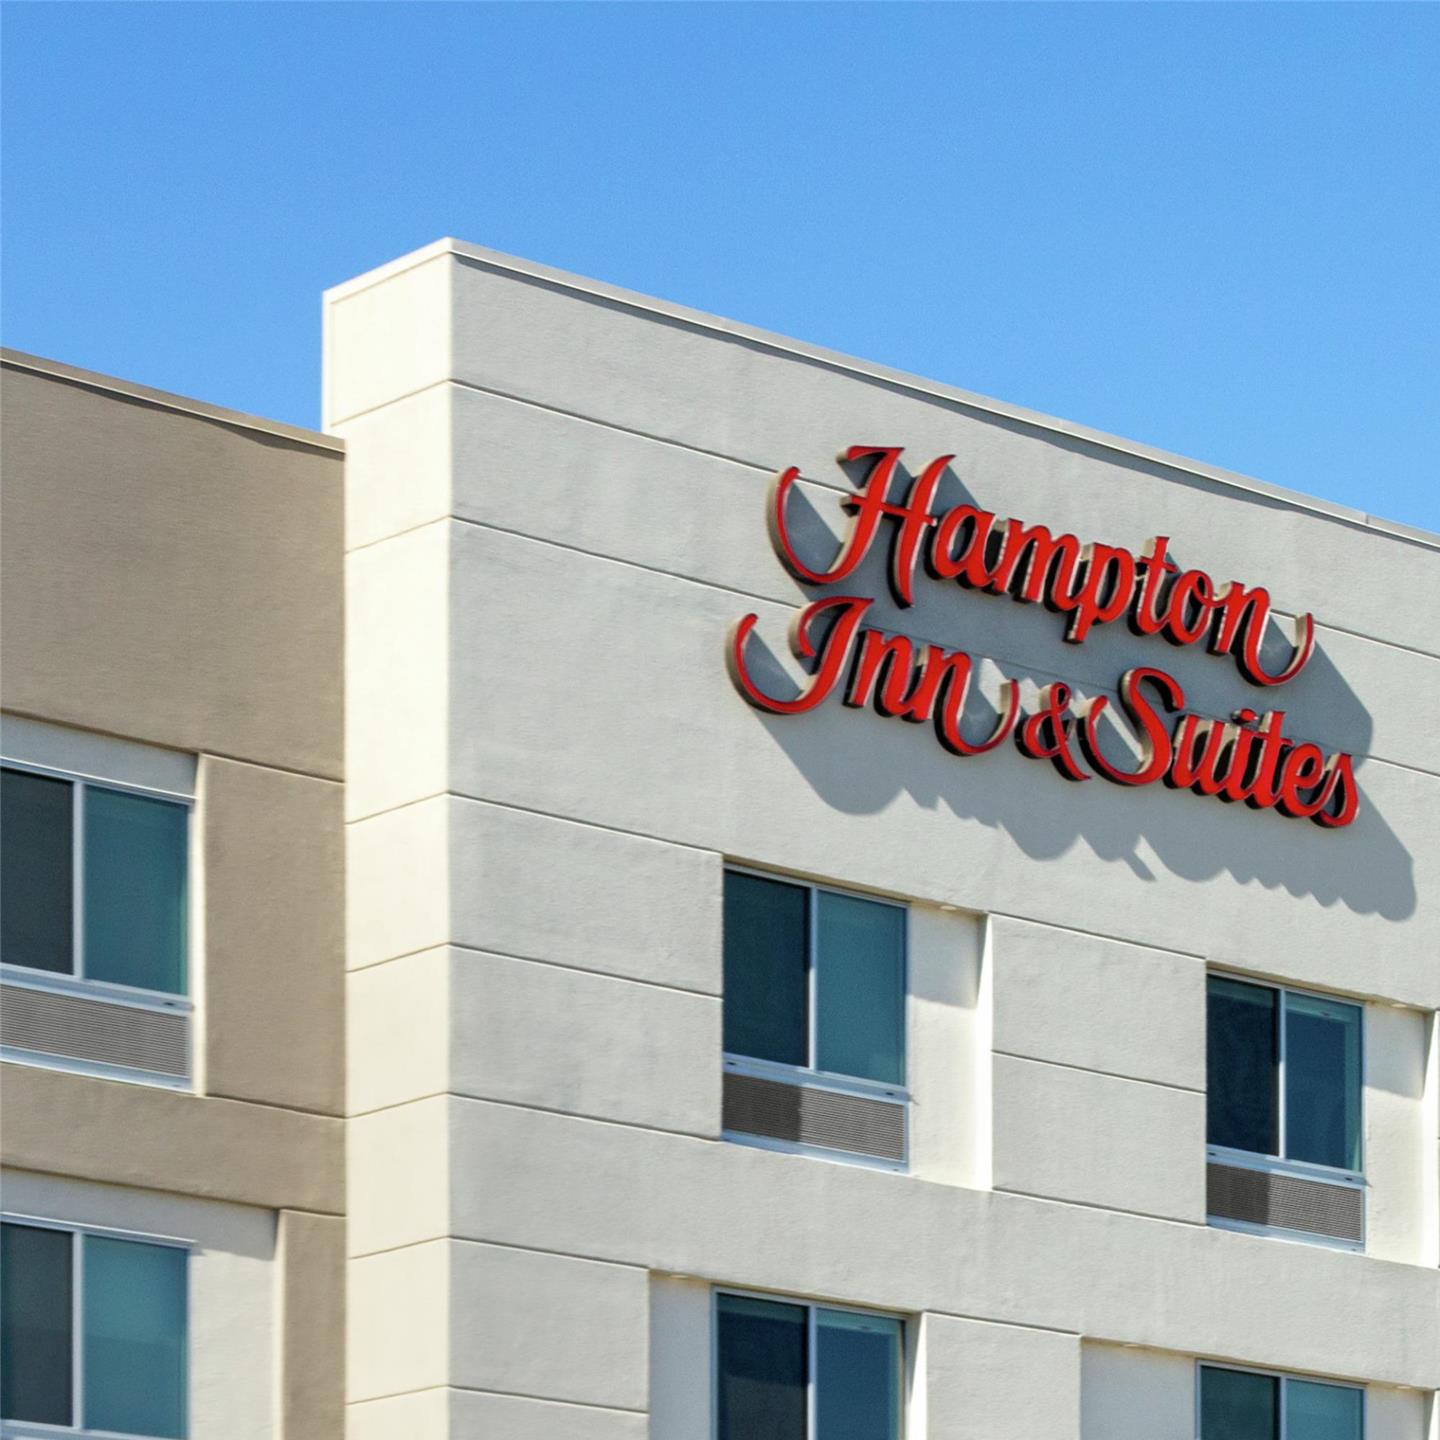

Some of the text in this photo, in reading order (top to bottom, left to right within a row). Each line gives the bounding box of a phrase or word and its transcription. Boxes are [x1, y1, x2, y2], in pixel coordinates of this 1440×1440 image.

[767, 446, 1314, 688] Hampton
[726, 596, 1360, 828] Inn & Suites
